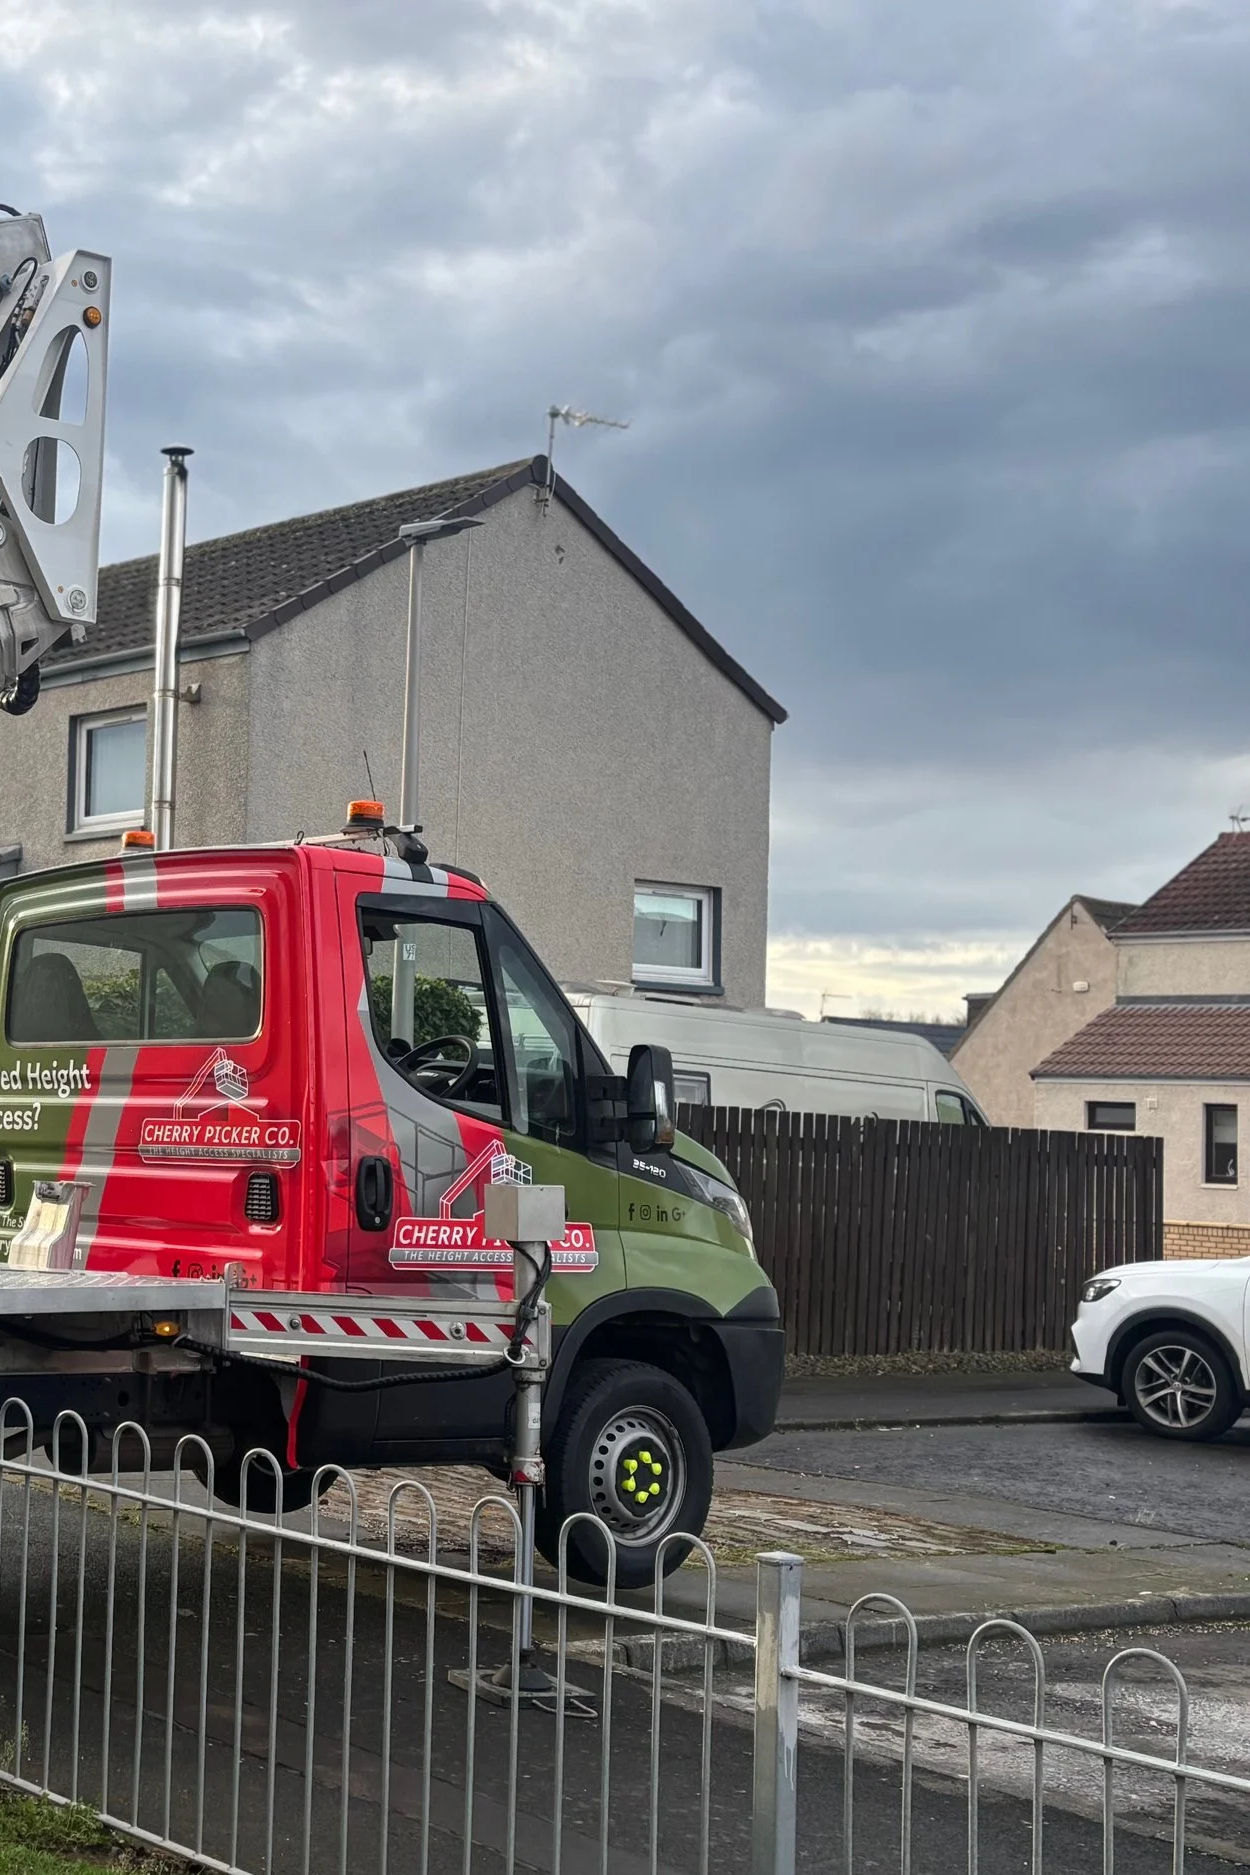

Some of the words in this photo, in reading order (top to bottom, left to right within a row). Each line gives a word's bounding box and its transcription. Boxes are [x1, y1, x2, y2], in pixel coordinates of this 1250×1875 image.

[27, 1059, 92, 1098] Height
[144, 1124, 202, 1144] CHERRY
[204, 1125, 261, 1145] PICKER
[264, 1126, 295, 1145] CO.
[148, 1146, 163, 1155] THE
[165, 1146, 195, 1156] HEIGHT
[199, 1147, 229, 1158] ACCESS
[231, 1149, 289, 1160] SPECIALISTS
[2, 1214, 16, 1228] The
[399, 1224, 478, 1246] CHERRY
[403, 1250, 424, 1260] THE
[428, 1251, 469, 1261] HEIGHT
[471, 1251, 513, 1263] ACCESS
